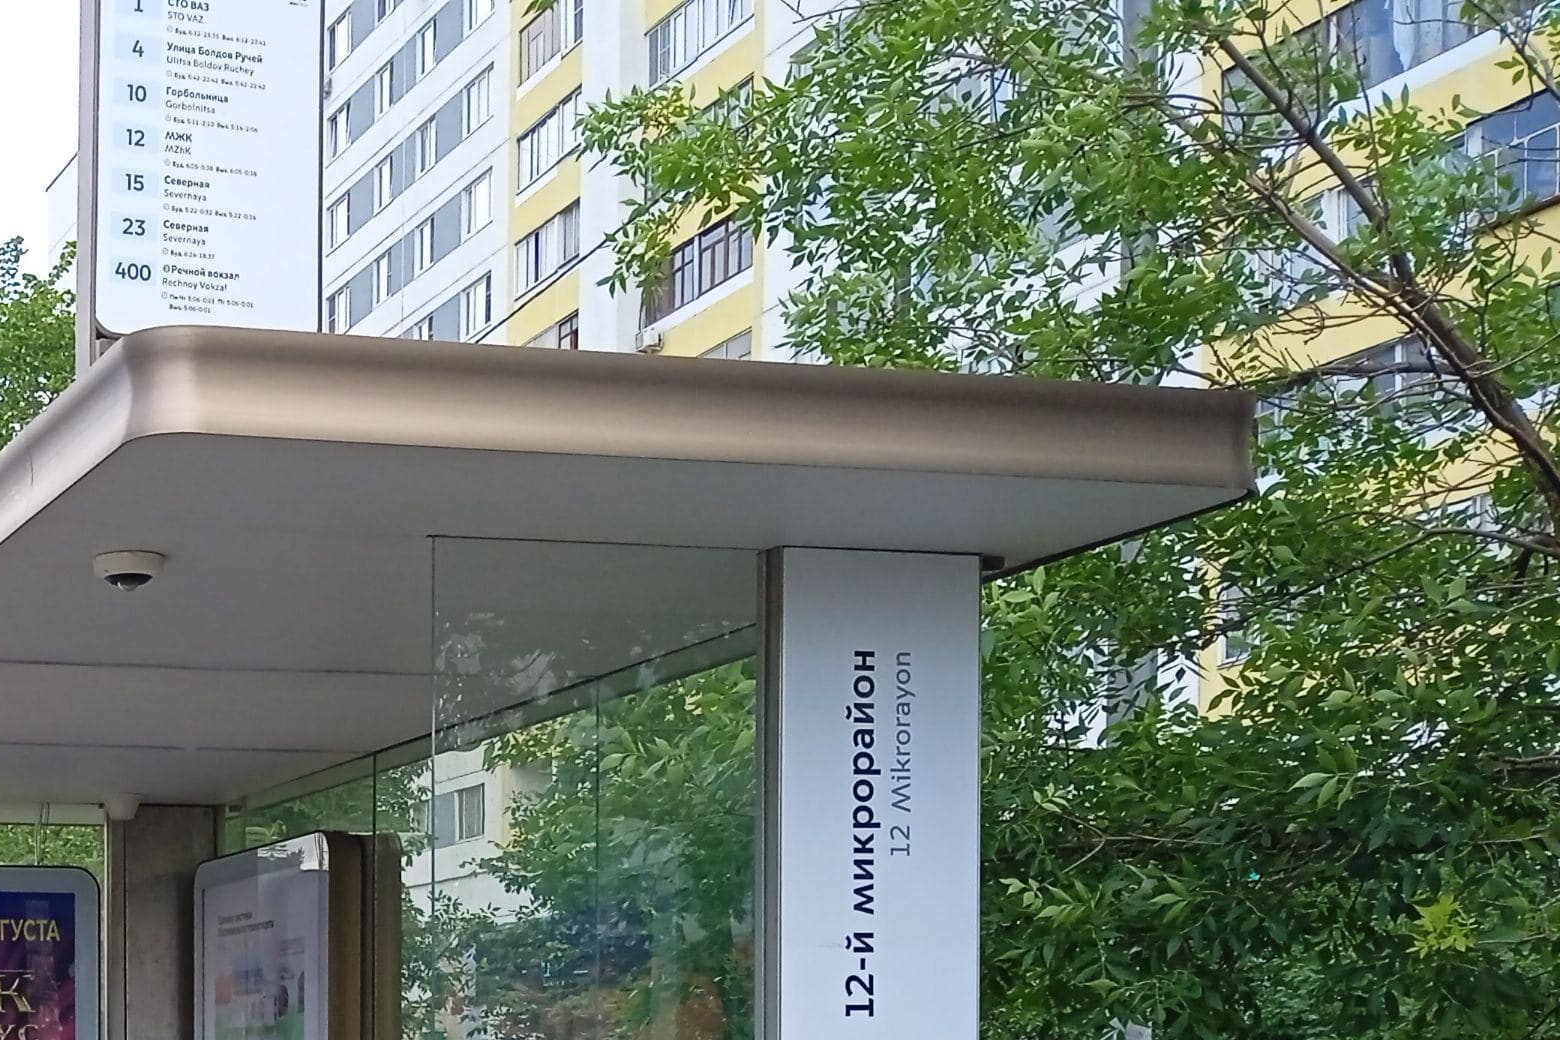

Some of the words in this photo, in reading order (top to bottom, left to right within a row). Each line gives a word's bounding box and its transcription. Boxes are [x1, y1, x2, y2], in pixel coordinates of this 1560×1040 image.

[191, 1, 209, 12] ВАЗ
[167, 11, 185, 20] STO
[187, 14, 204, 23] VAZ
[132, 40, 144, 57] 4
[166, 42, 196, 54] Улица
[198, 47, 233, 60] Болдов
[235, 52, 263, 64] Ручей
[166, 56, 191, 67] Ulitsa
[193, 59, 222, 71] Boldov
[224, 64, 255, 77] Ruchey
[127, 84, 147, 102] 10
[166, 86, 229, 103] Горбольница
[165, 100, 216, 114] Gorbolnitsa
[126, 128, 145, 147] 12
[164, 131, 192, 143] МЖК
[164, 145, 191, 155] MZhK
[125, 173, 145, 192] 15
[164, 175, 210, 189] Северная
[164, 189, 207, 202] Severnaya
[122, 218, 146, 237] 23
[163, 219, 209, 233] Северная
[163, 233, 206, 247] Severnaya
[115, 261, 152, 281] 400
[171, 265, 206, 277] Речной
[207, 271, 240, 281] вокзал
[162, 277, 198, 290] Rechnoy
[200, 280, 227, 292] Vokzal
[890, 651, 916, 814] Mikrorayon
[845, 650, 881, 915] микрорайон
[890, 825, 911, 856] 12
[845, 932, 875, 1017] 12-й
